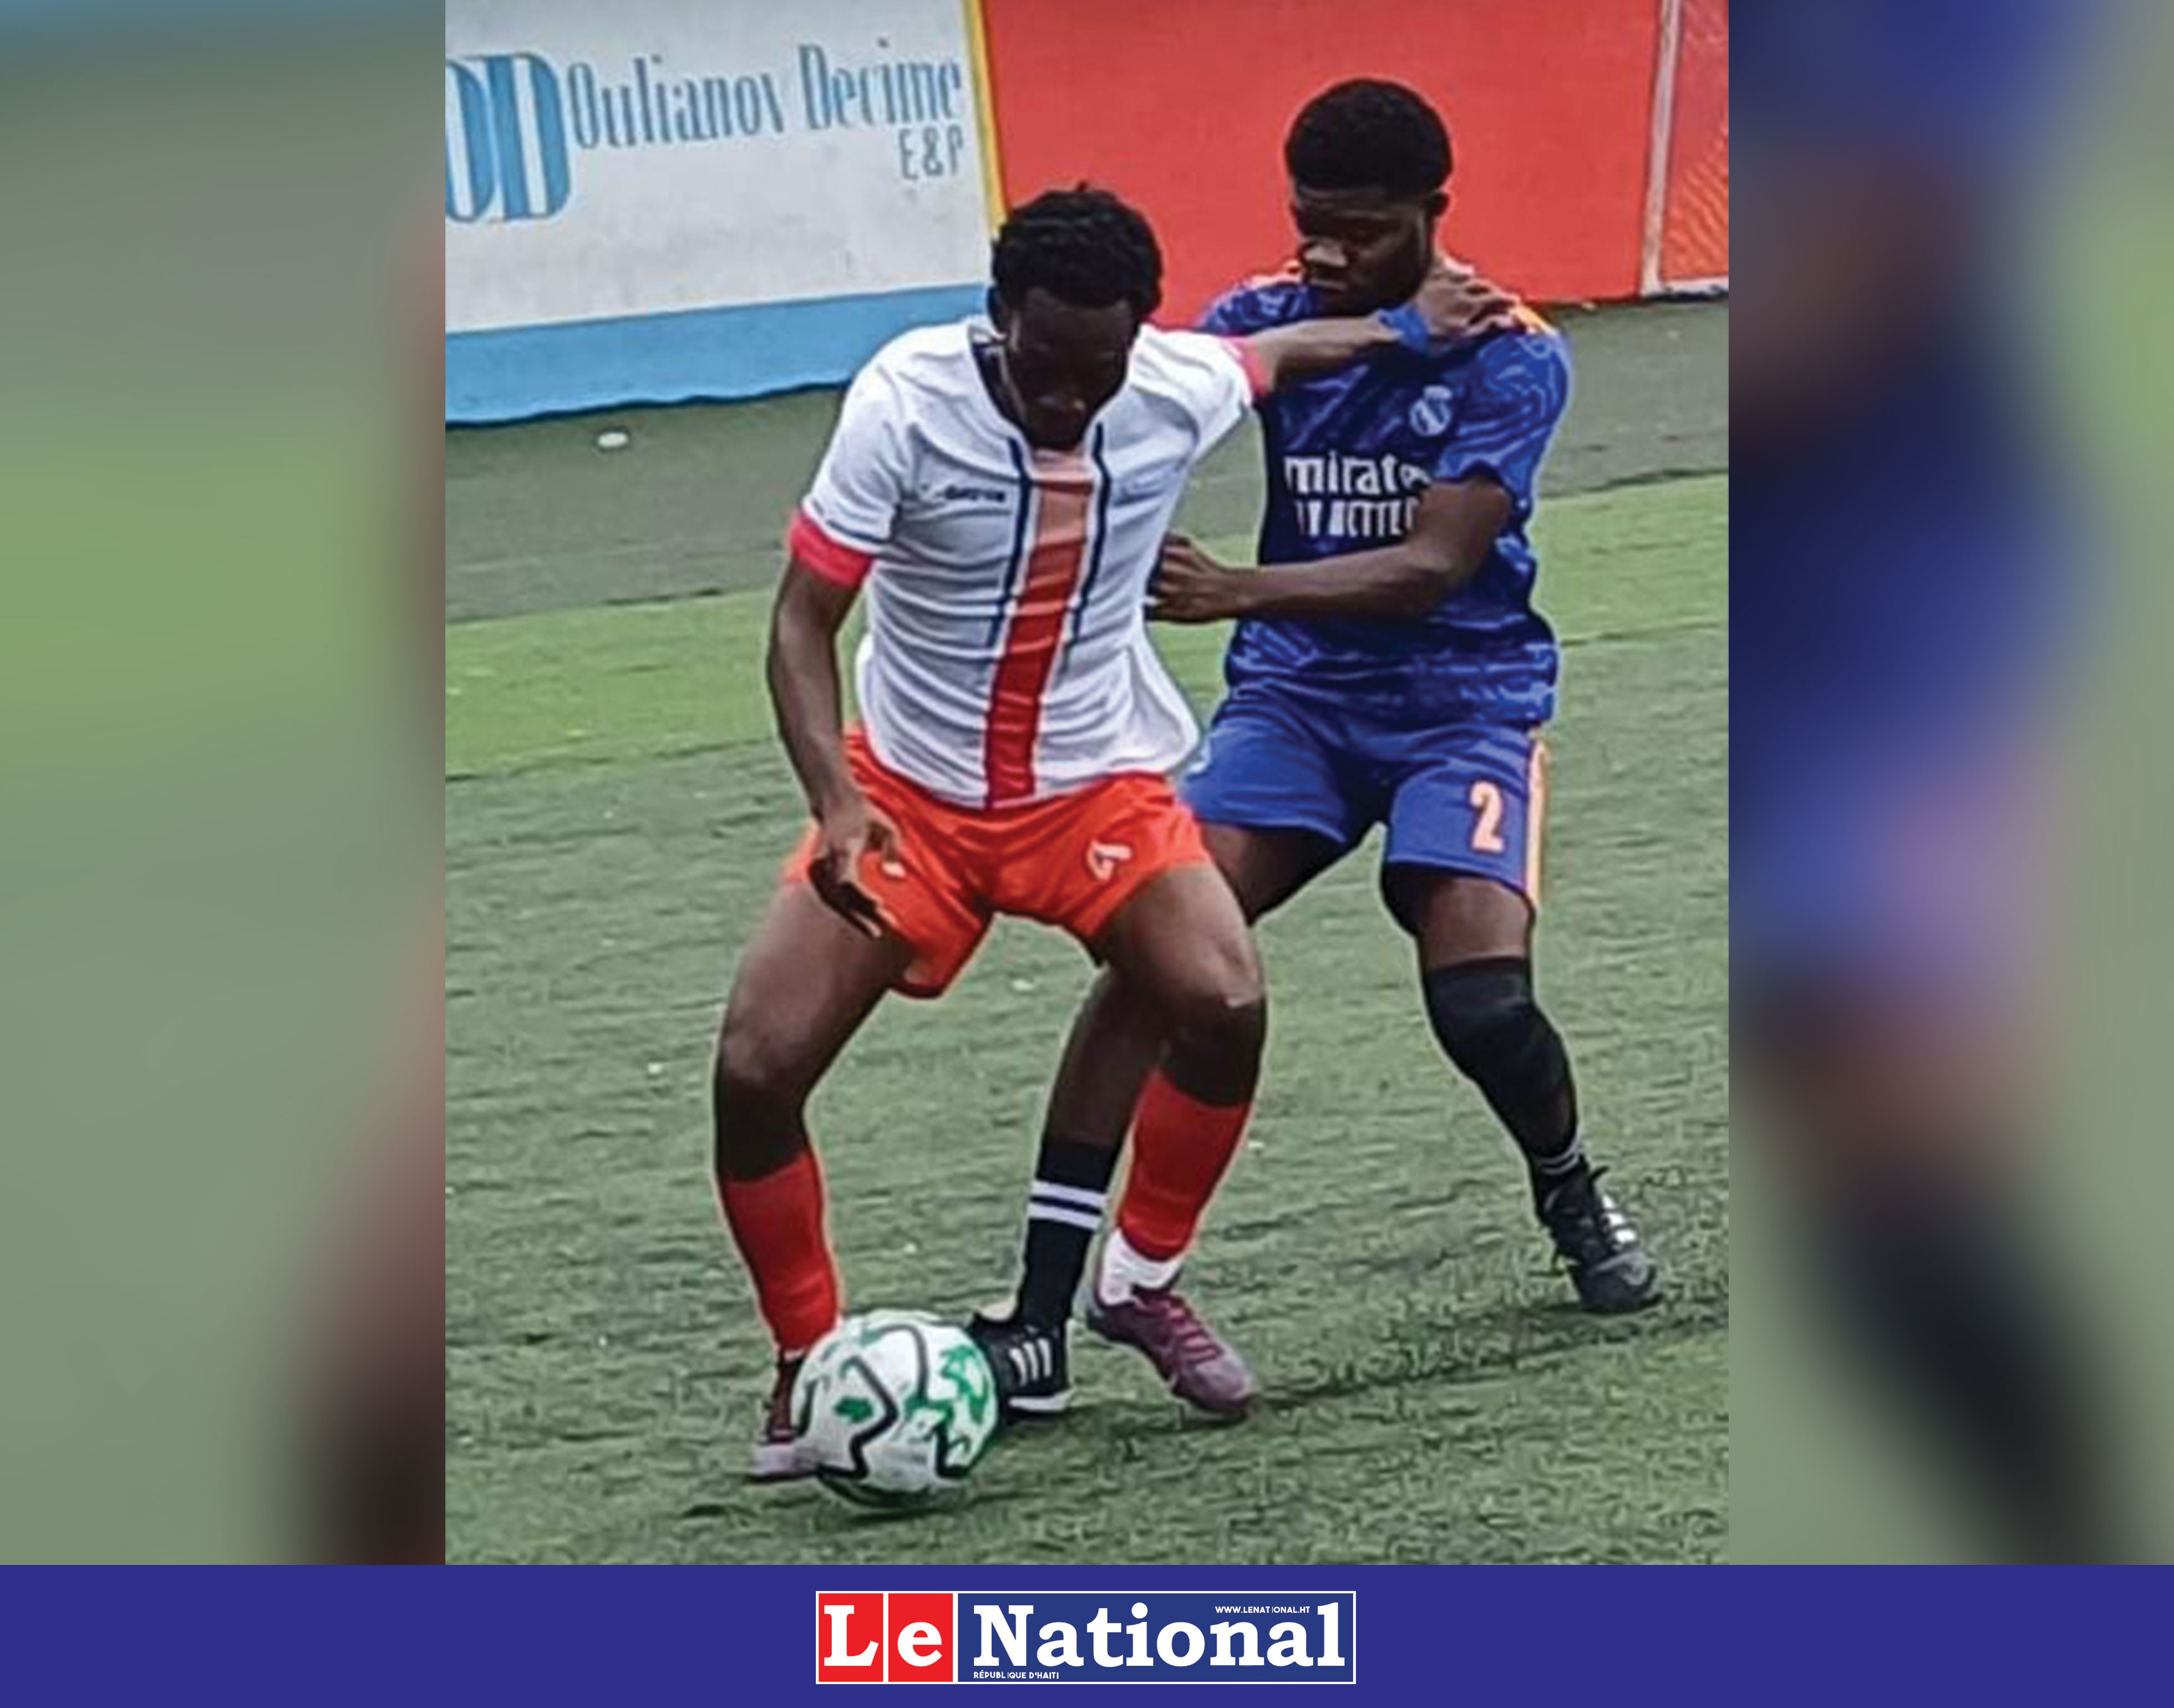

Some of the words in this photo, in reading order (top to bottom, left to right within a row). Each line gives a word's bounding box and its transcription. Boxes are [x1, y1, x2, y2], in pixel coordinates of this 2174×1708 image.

[566, 54, 785, 150] Oulianov
[798, 37, 963, 131] Decime
[898, 124, 963, 181] E&P
[1470, 781, 1505, 852] 2
